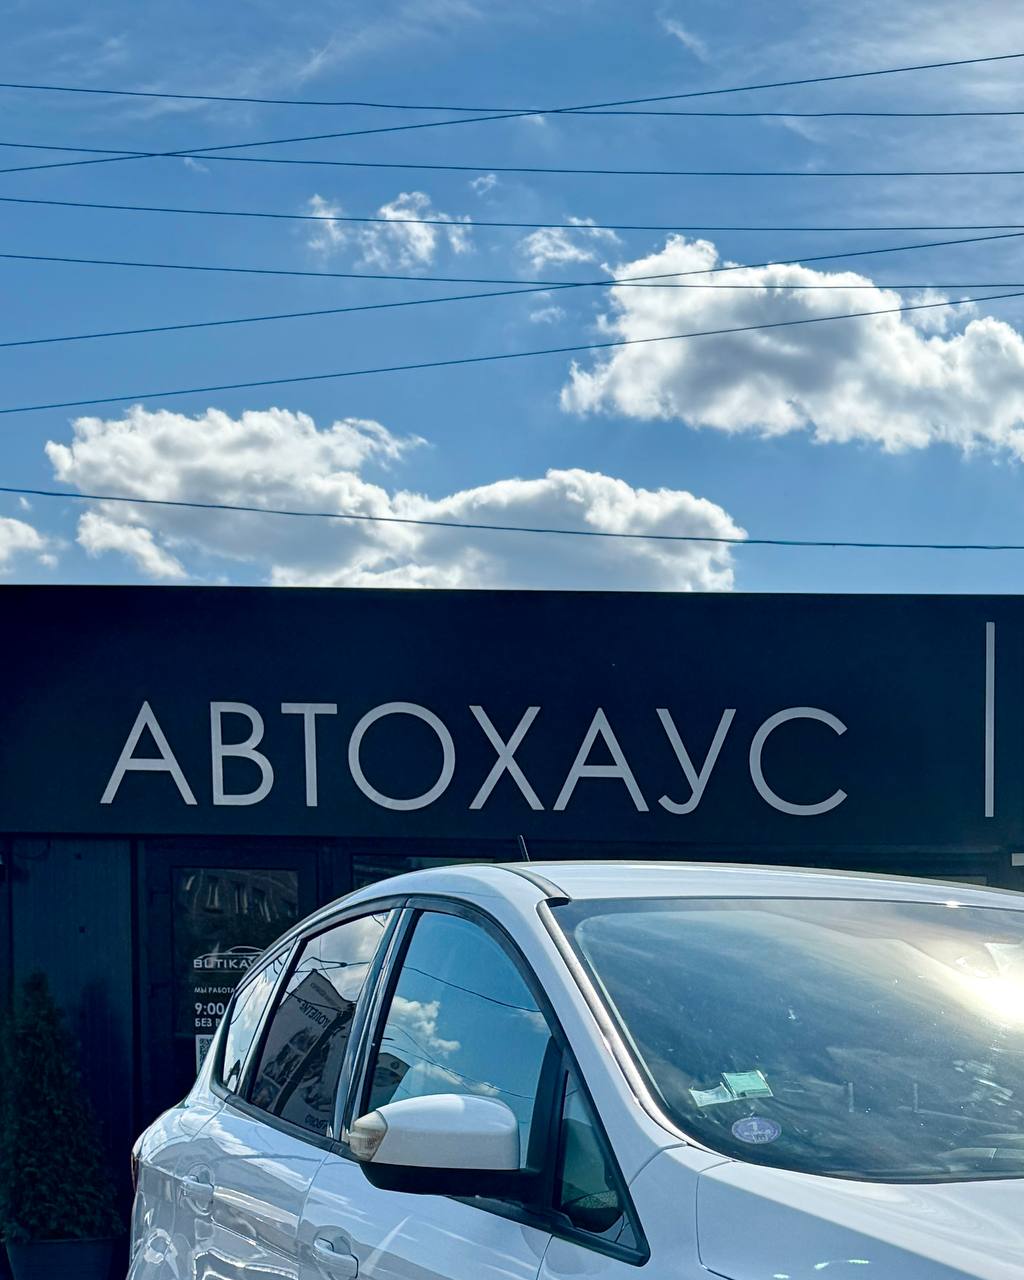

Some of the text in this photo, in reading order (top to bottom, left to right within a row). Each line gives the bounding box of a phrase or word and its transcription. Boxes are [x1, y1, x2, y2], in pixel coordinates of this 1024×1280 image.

[99, 700, 849, 817] АВТОХАУС
[194, 1002, 225, 1015] 9:00
[194, 1018, 212, 1027] БЕЗ
